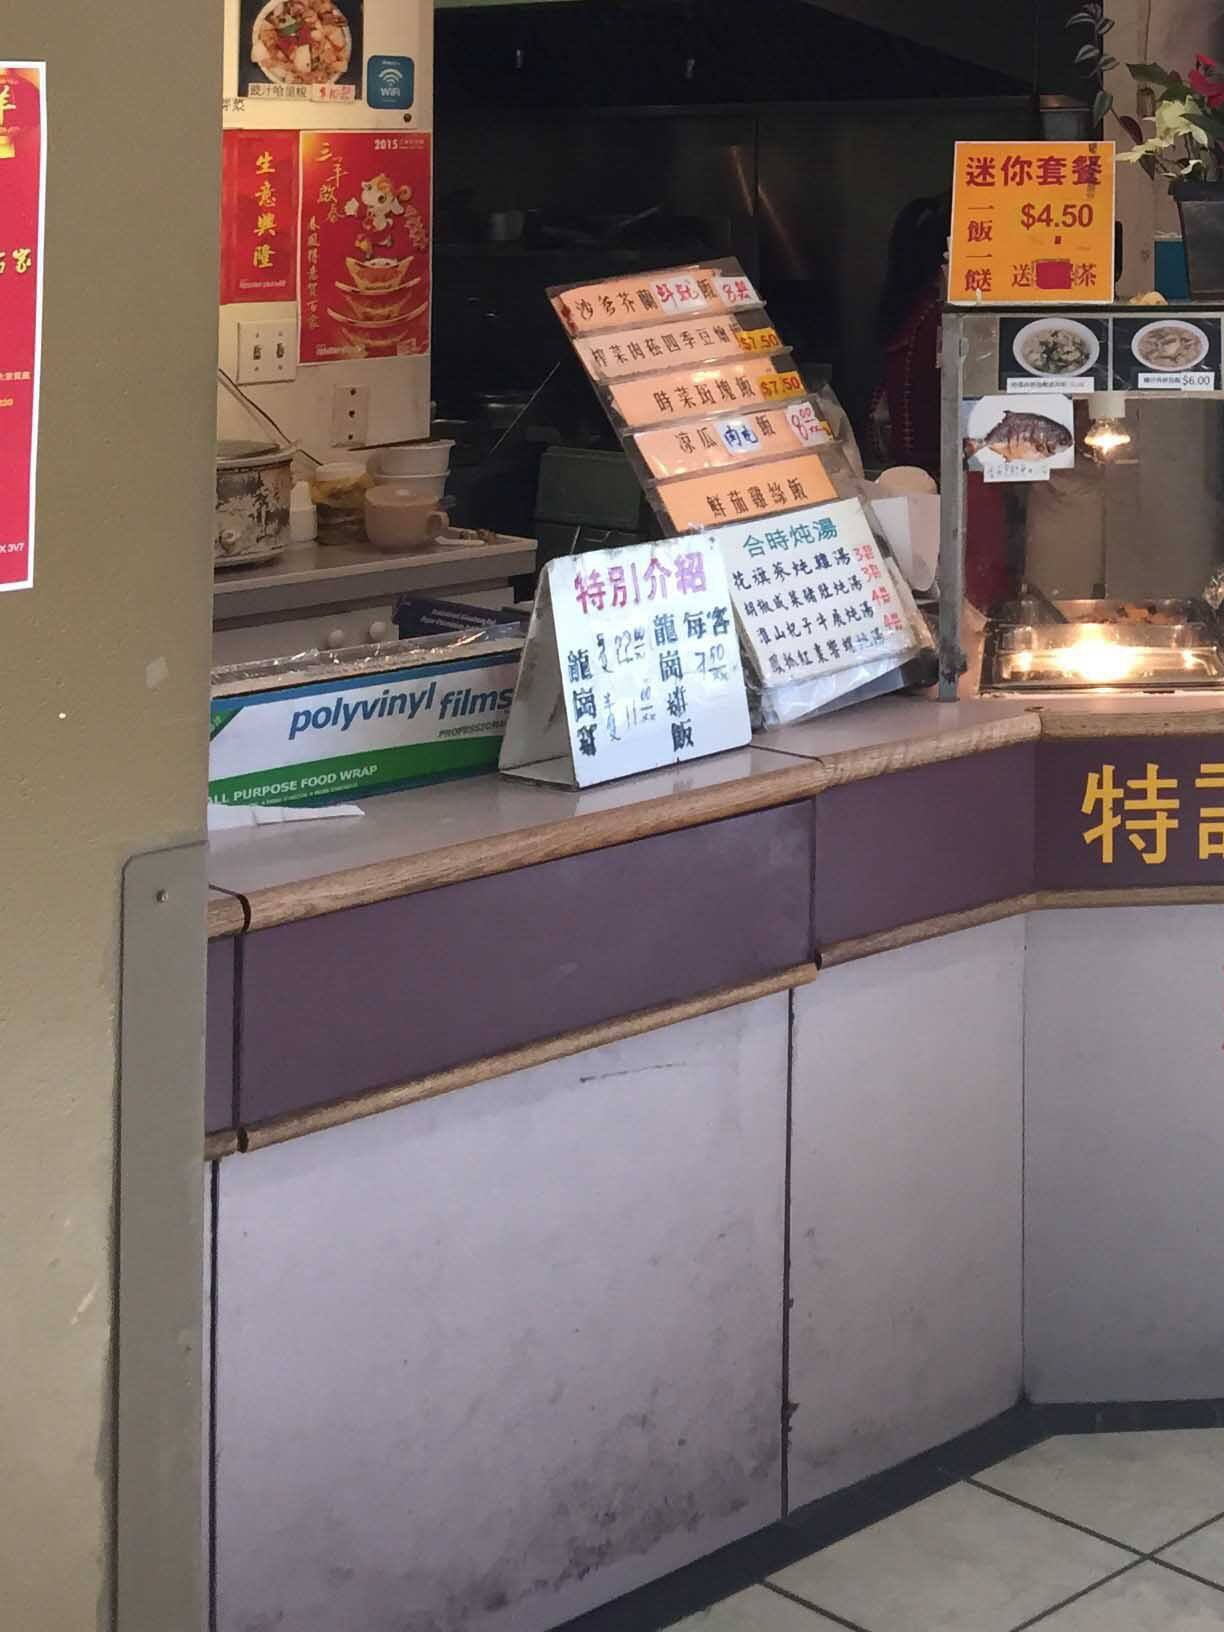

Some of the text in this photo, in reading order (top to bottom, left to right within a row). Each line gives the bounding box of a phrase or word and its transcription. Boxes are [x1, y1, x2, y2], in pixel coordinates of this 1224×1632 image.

[374, 138, 399, 151] 2015
[965, 155, 1103, 187] 迷你套餐
[253, 151, 278, 269] 生意興隆
[1020, 203, 1094, 230] $4.50
[1182, 373, 1211, 386] $6.00
[743, 517, 838, 559] 合時炖湯
[574, 551, 707, 614] 特別介紹
[288, 681, 513, 740] polyvinyl films
[233, 780, 298, 801] PURPOSE
[300, 772, 337, 789] FOOD
[340, 765, 378, 782] WRAP
